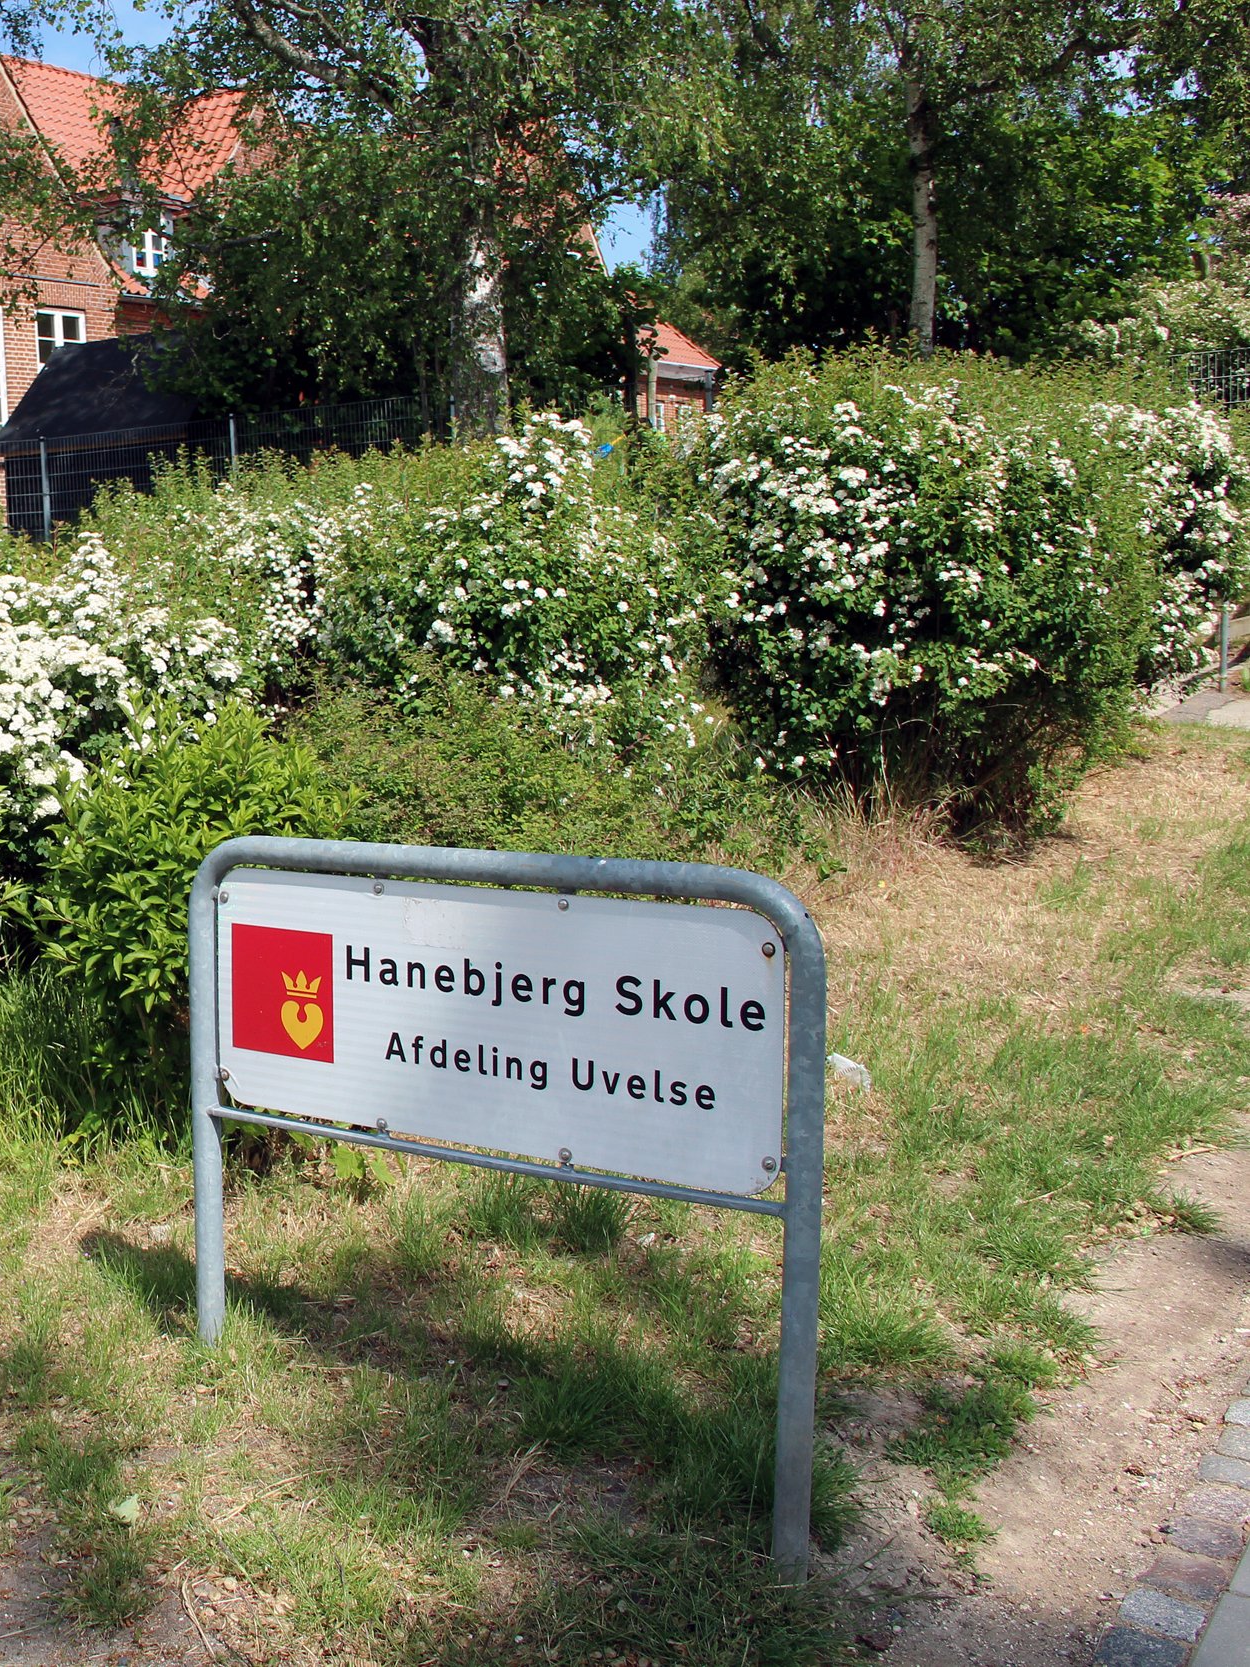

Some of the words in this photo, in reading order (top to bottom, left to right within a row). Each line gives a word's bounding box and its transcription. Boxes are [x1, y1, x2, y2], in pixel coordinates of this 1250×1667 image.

[346, 945, 586, 1017] Hanebjerg
[614, 975, 766, 1032] Skole
[384, 1032, 548, 1091] Afdeling
[571, 1057, 716, 1111] Uvelse
